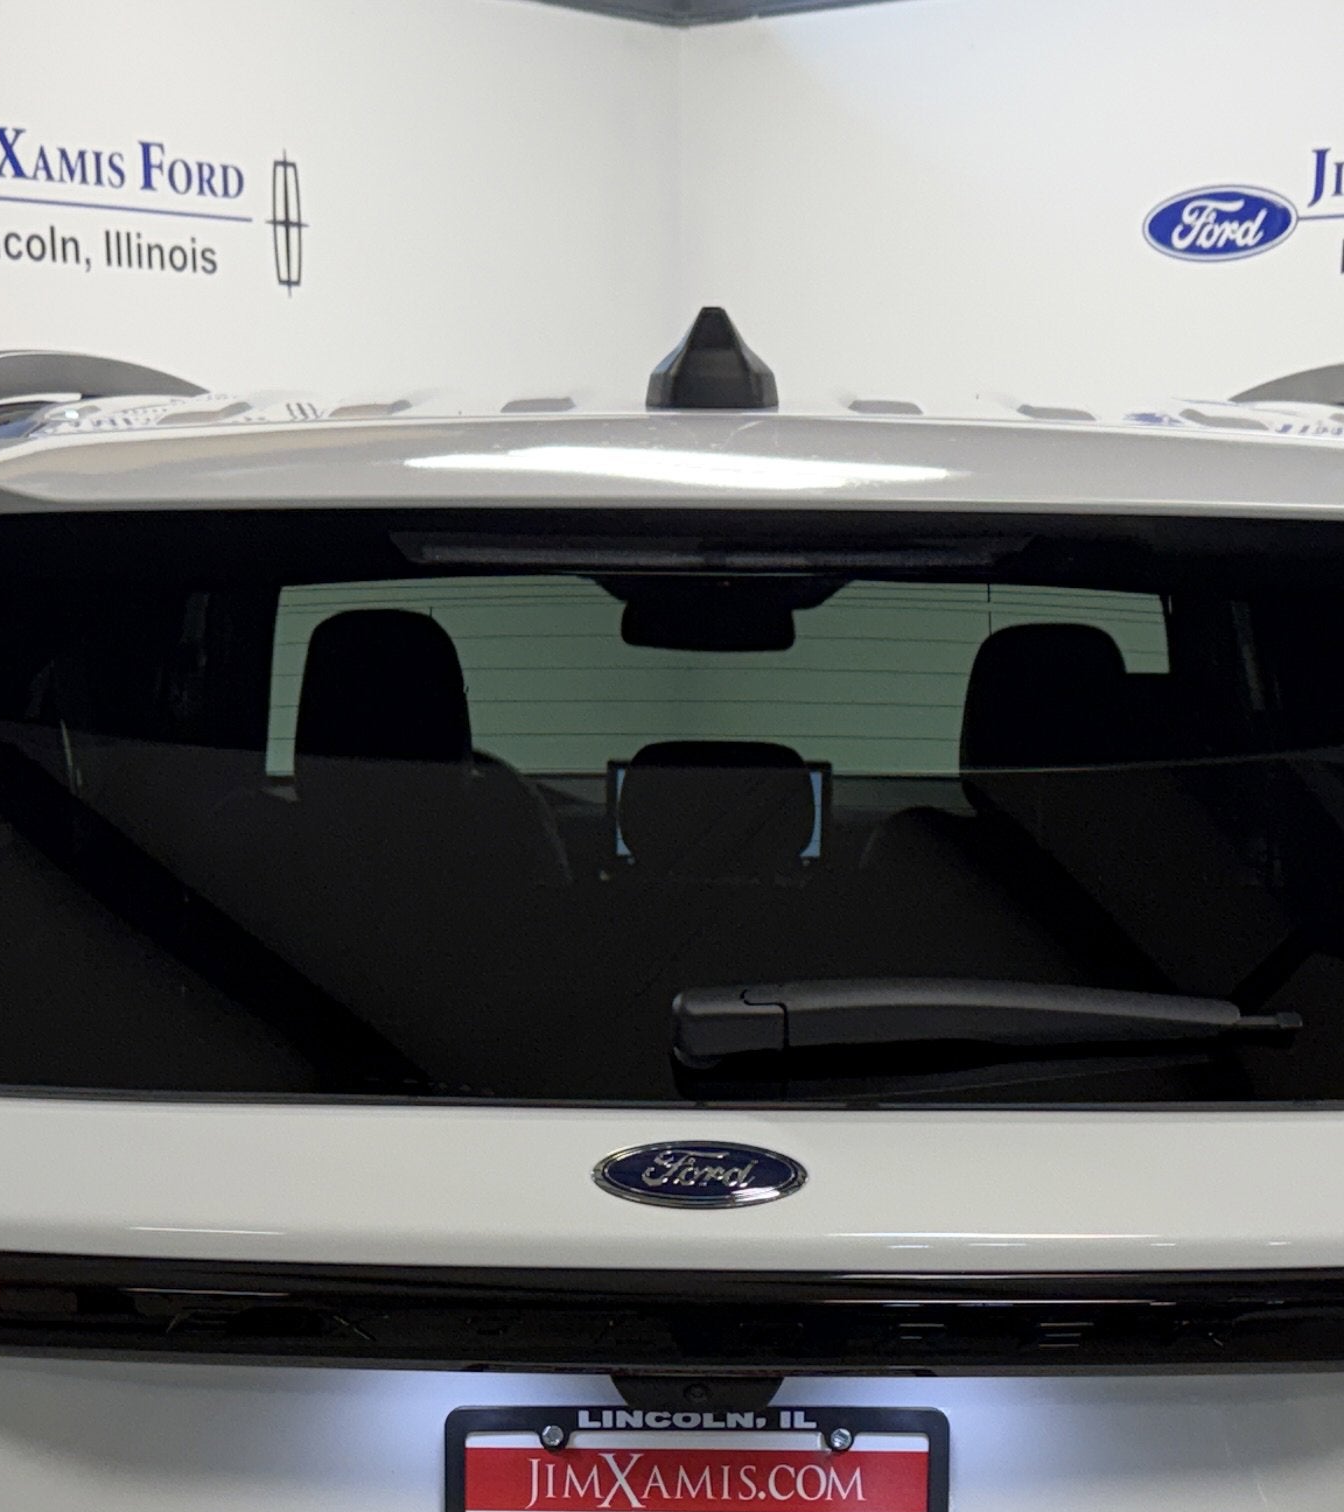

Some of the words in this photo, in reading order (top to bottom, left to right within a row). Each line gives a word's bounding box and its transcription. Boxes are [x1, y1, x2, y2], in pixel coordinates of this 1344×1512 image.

[137, 140, 245, 200] FORD
[1172, 199, 1265, 250] Ford
[105, 230, 218, 275] Illinois
[641, 1149, 759, 1188] Ford
[578, 1410, 766, 1428] LINCOLN,
[780, 1411, 817, 1428] IL
[525, 1452, 867, 1509] JIMXAMIS.COM
